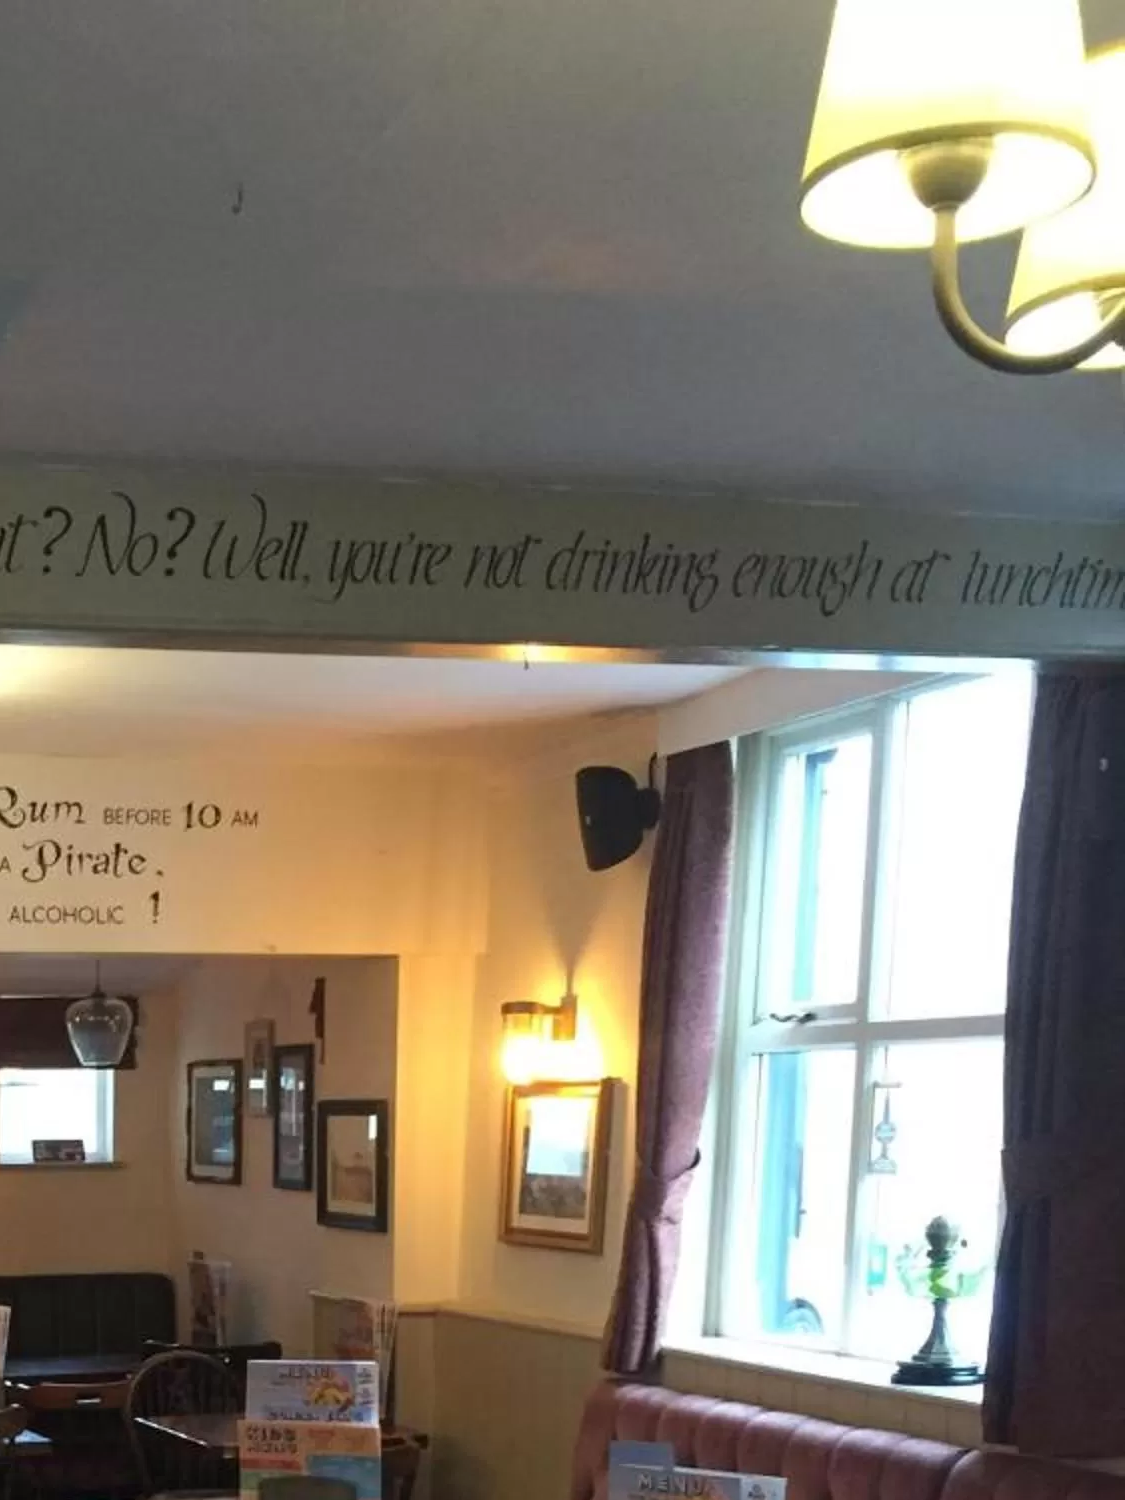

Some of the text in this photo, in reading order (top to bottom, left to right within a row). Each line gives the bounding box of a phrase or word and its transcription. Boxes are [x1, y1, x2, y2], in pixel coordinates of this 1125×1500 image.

[75, 491, 195, 577] No?
[203, 493, 309, 584] Well,
[327, 531, 453, 602] you're
[463, 533, 542, 588] not
[546, 529, 719, 614] drinking
[732, 539, 883, 616] enough
[890, 549, 951, 604] at
[961, 547, 1125, 609] lunchtim
[102, 806, 172, 827] BEFORE
[182, 799, 222, 831] 10
[230, 808, 260, 828] AM
[7, 904, 124, 925] ALCOHOLIC
